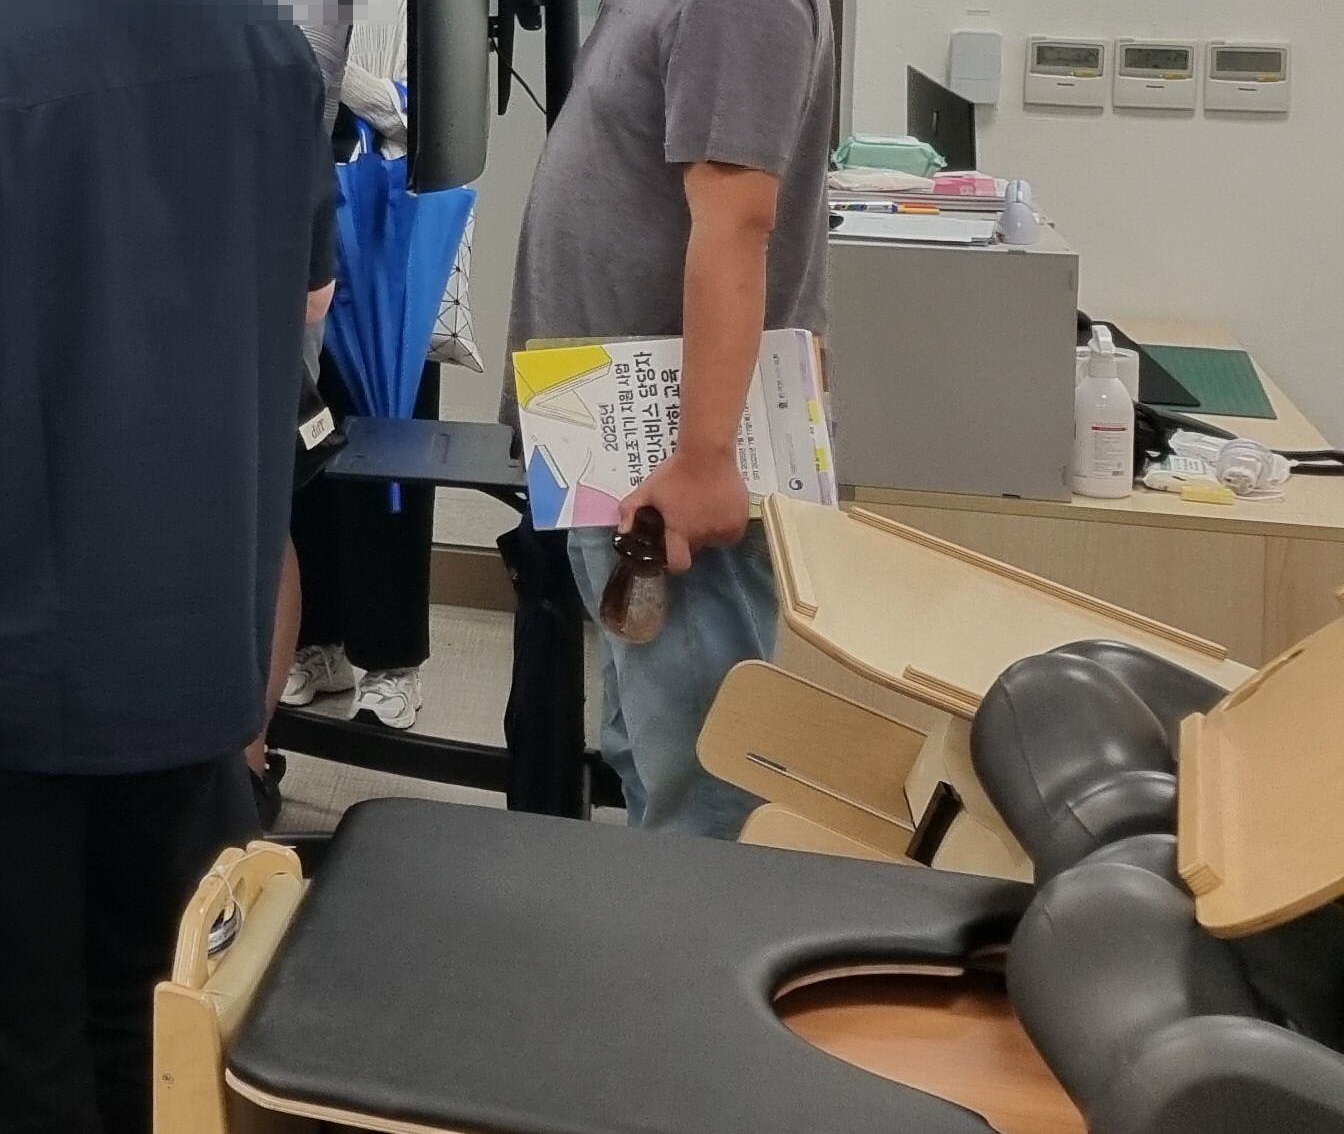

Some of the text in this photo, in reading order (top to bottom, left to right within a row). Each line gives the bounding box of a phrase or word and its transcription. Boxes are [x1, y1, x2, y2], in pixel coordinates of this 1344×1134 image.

[614, 363, 632, 386] 사업
[633, 351, 658, 398] 담당자
[617, 390, 635, 413] 지원
[598, 403, 619, 452] 2025년
